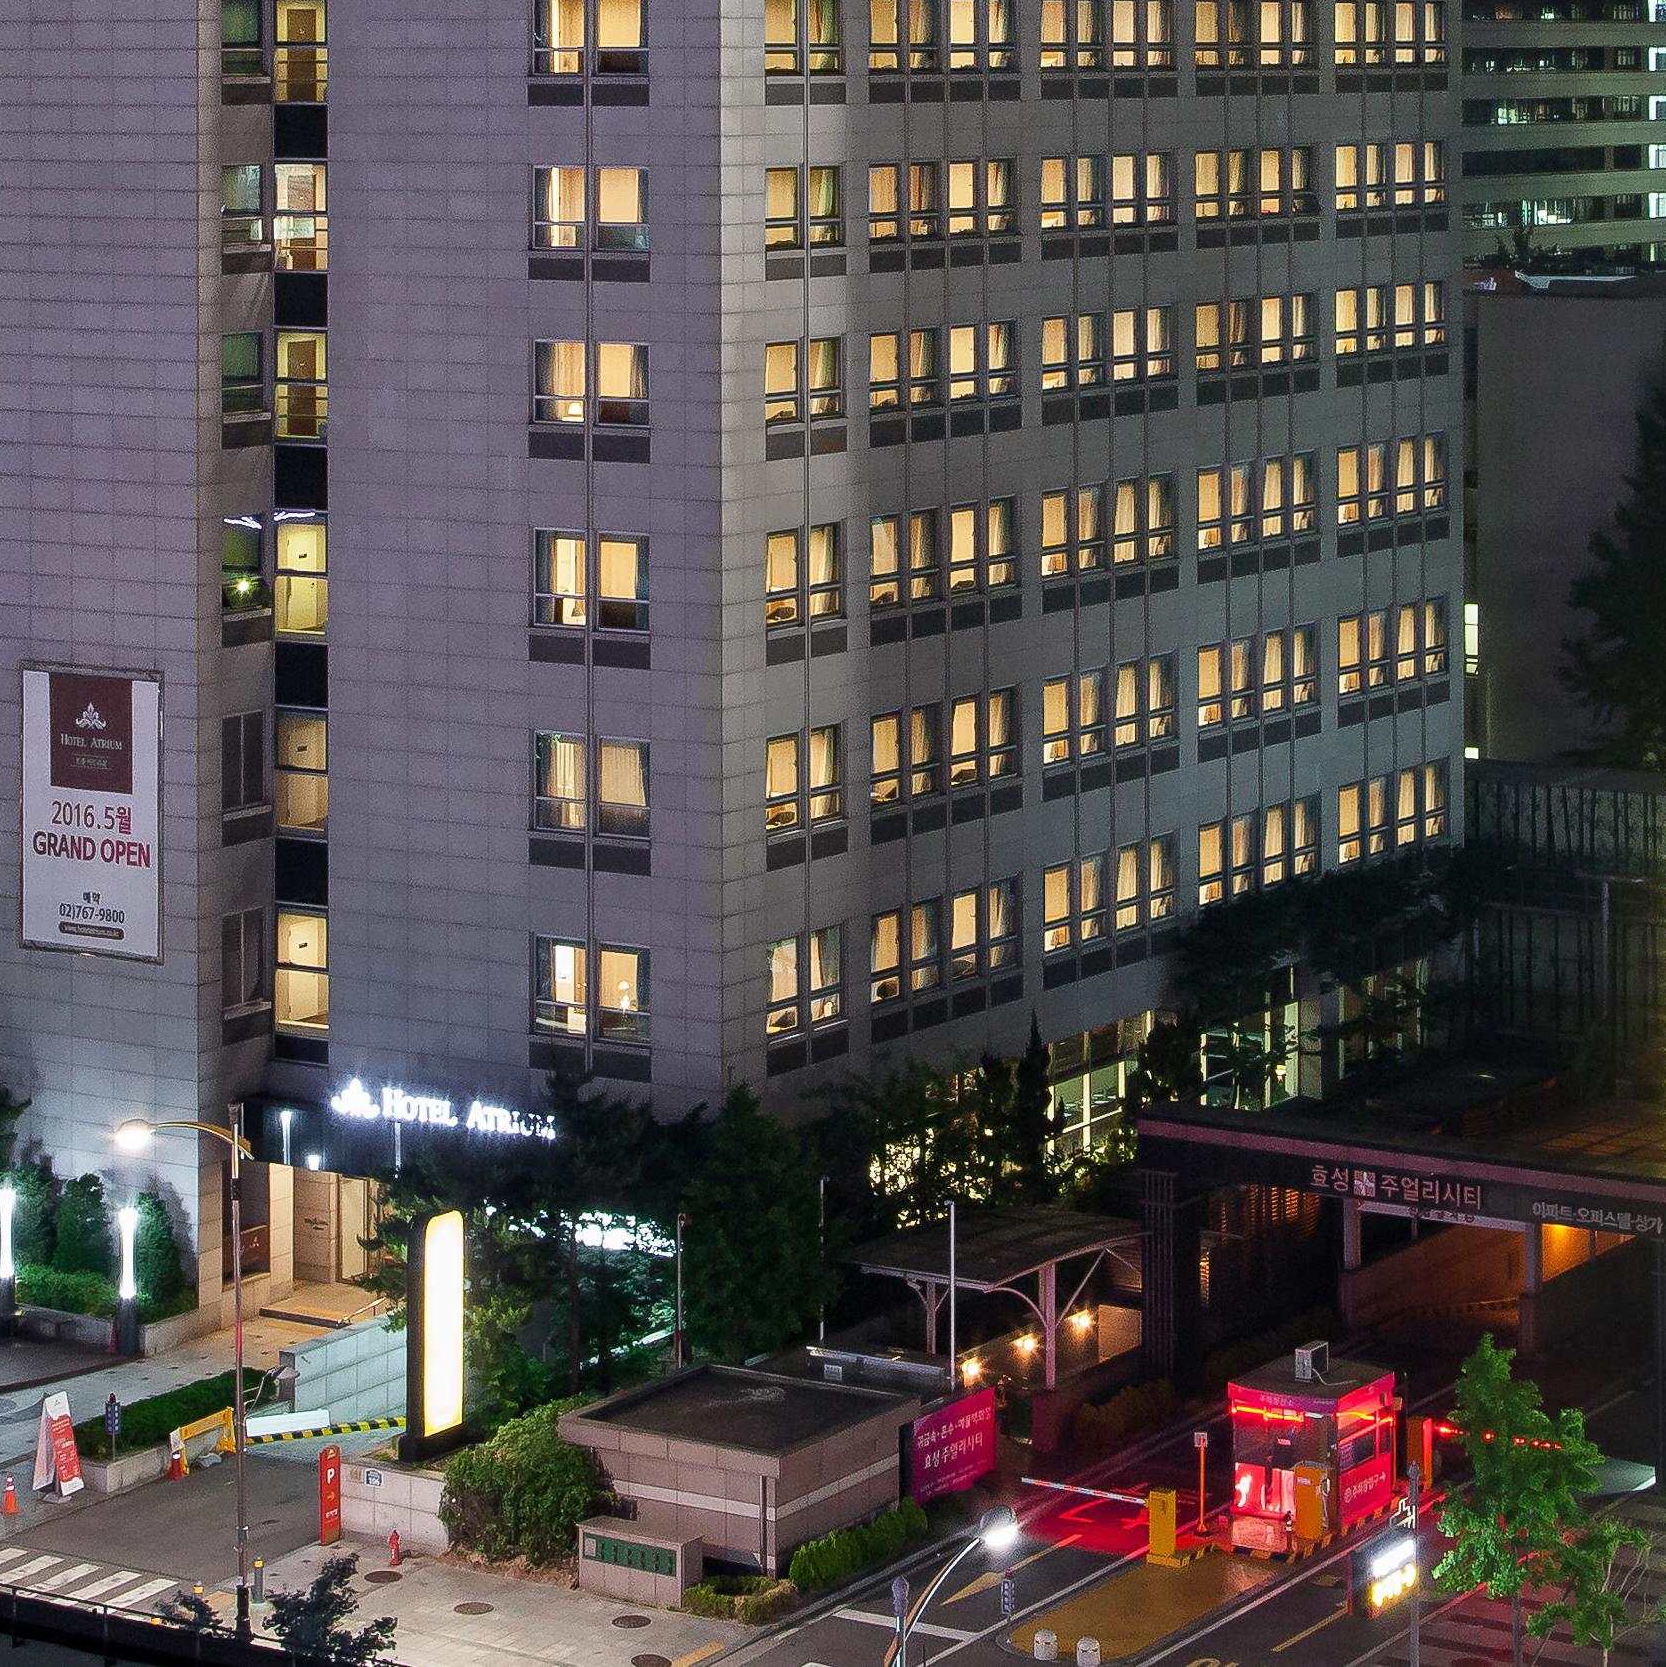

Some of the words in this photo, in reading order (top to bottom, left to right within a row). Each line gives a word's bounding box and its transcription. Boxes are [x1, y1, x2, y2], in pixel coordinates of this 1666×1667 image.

[60, 733, 86, 748] HOTEL
[90, 737, 123, 751] ATRIUM
[51, 800, 132, 835] 2016.5월
[33, 831, 96, 862] GRAND
[100, 838, 151, 868] OPEN
[59, 902, 125, 924] 02)767-9800
[383, 1087, 458, 1127] HOTEL
[1309, 1165, 1350, 1192] 효성
[1380, 1175, 1482, 1210] 주얼리시티
